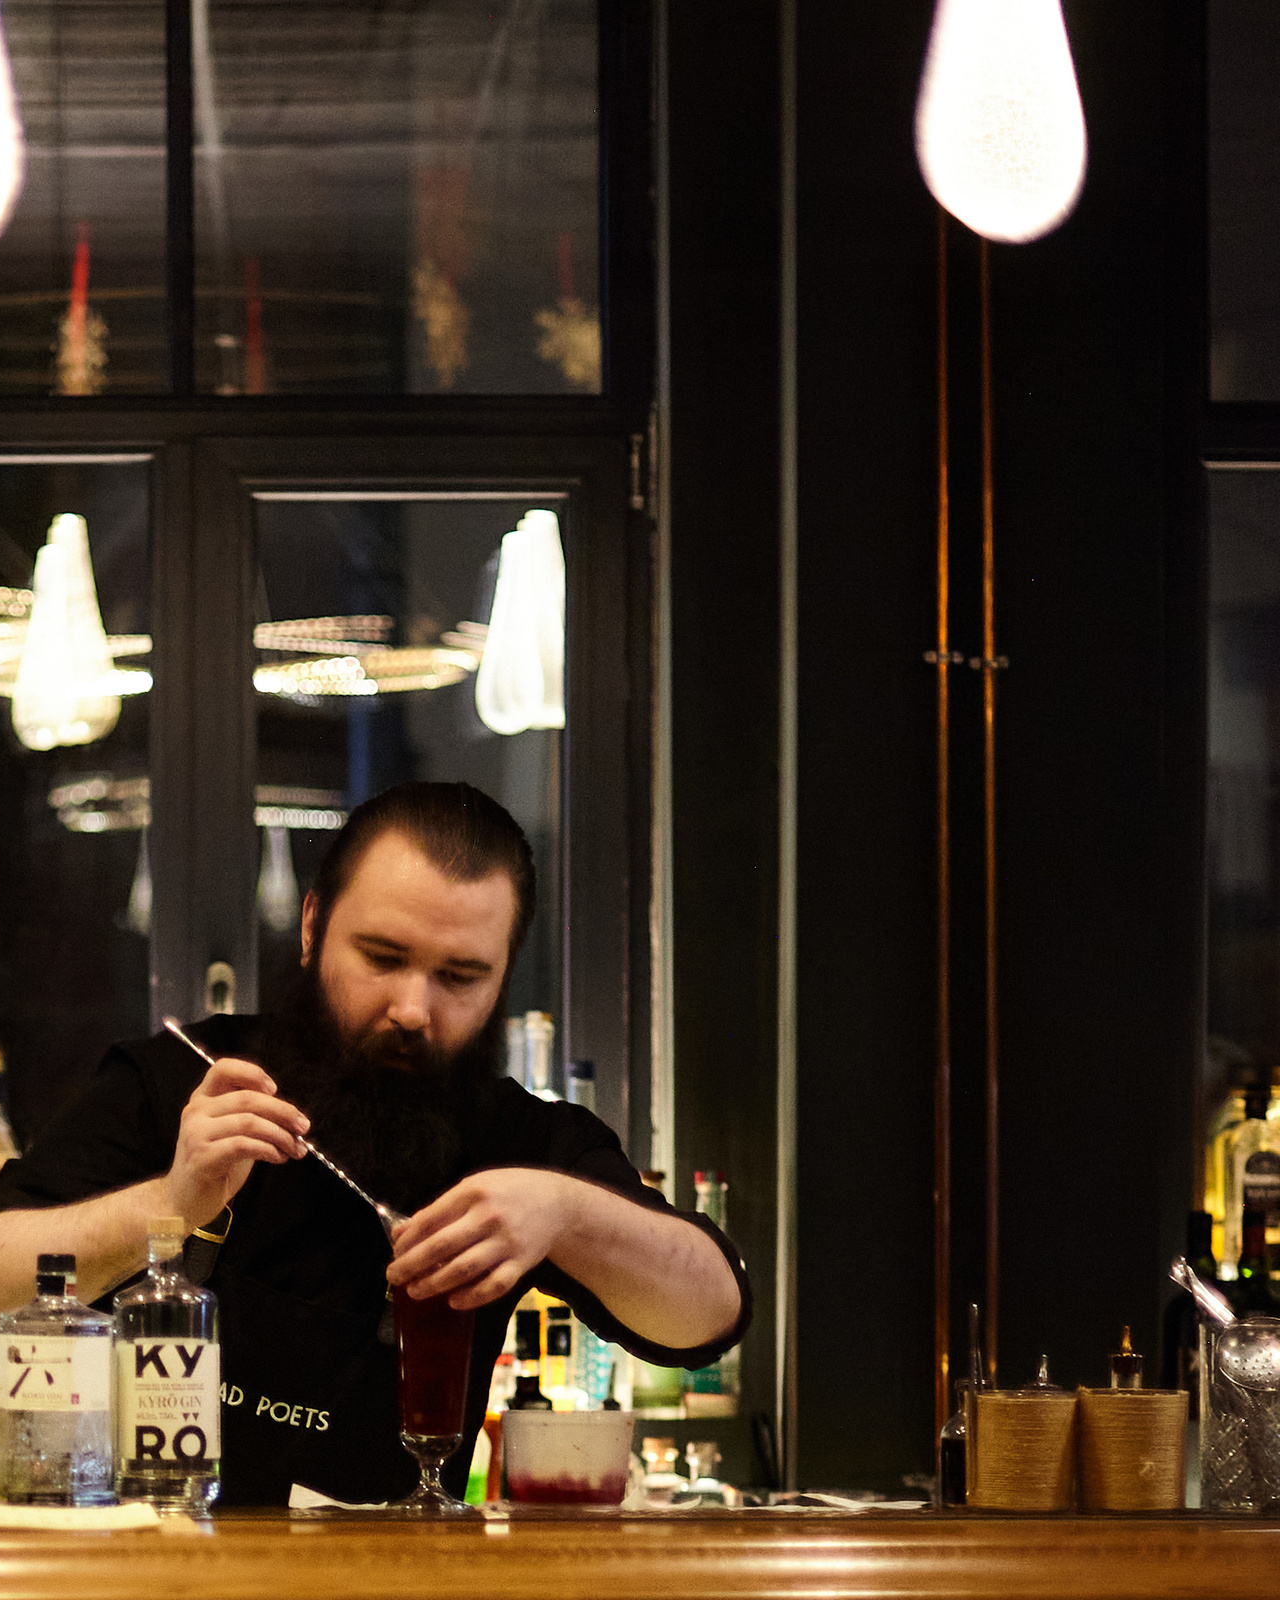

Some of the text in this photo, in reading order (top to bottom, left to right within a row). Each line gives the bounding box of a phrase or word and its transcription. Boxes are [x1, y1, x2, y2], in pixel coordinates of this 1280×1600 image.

[135, 1345, 204, 1378] KY
[180, 1395, 202, 1408] GIN
[220, 1382, 330, 1431] AD POETS
